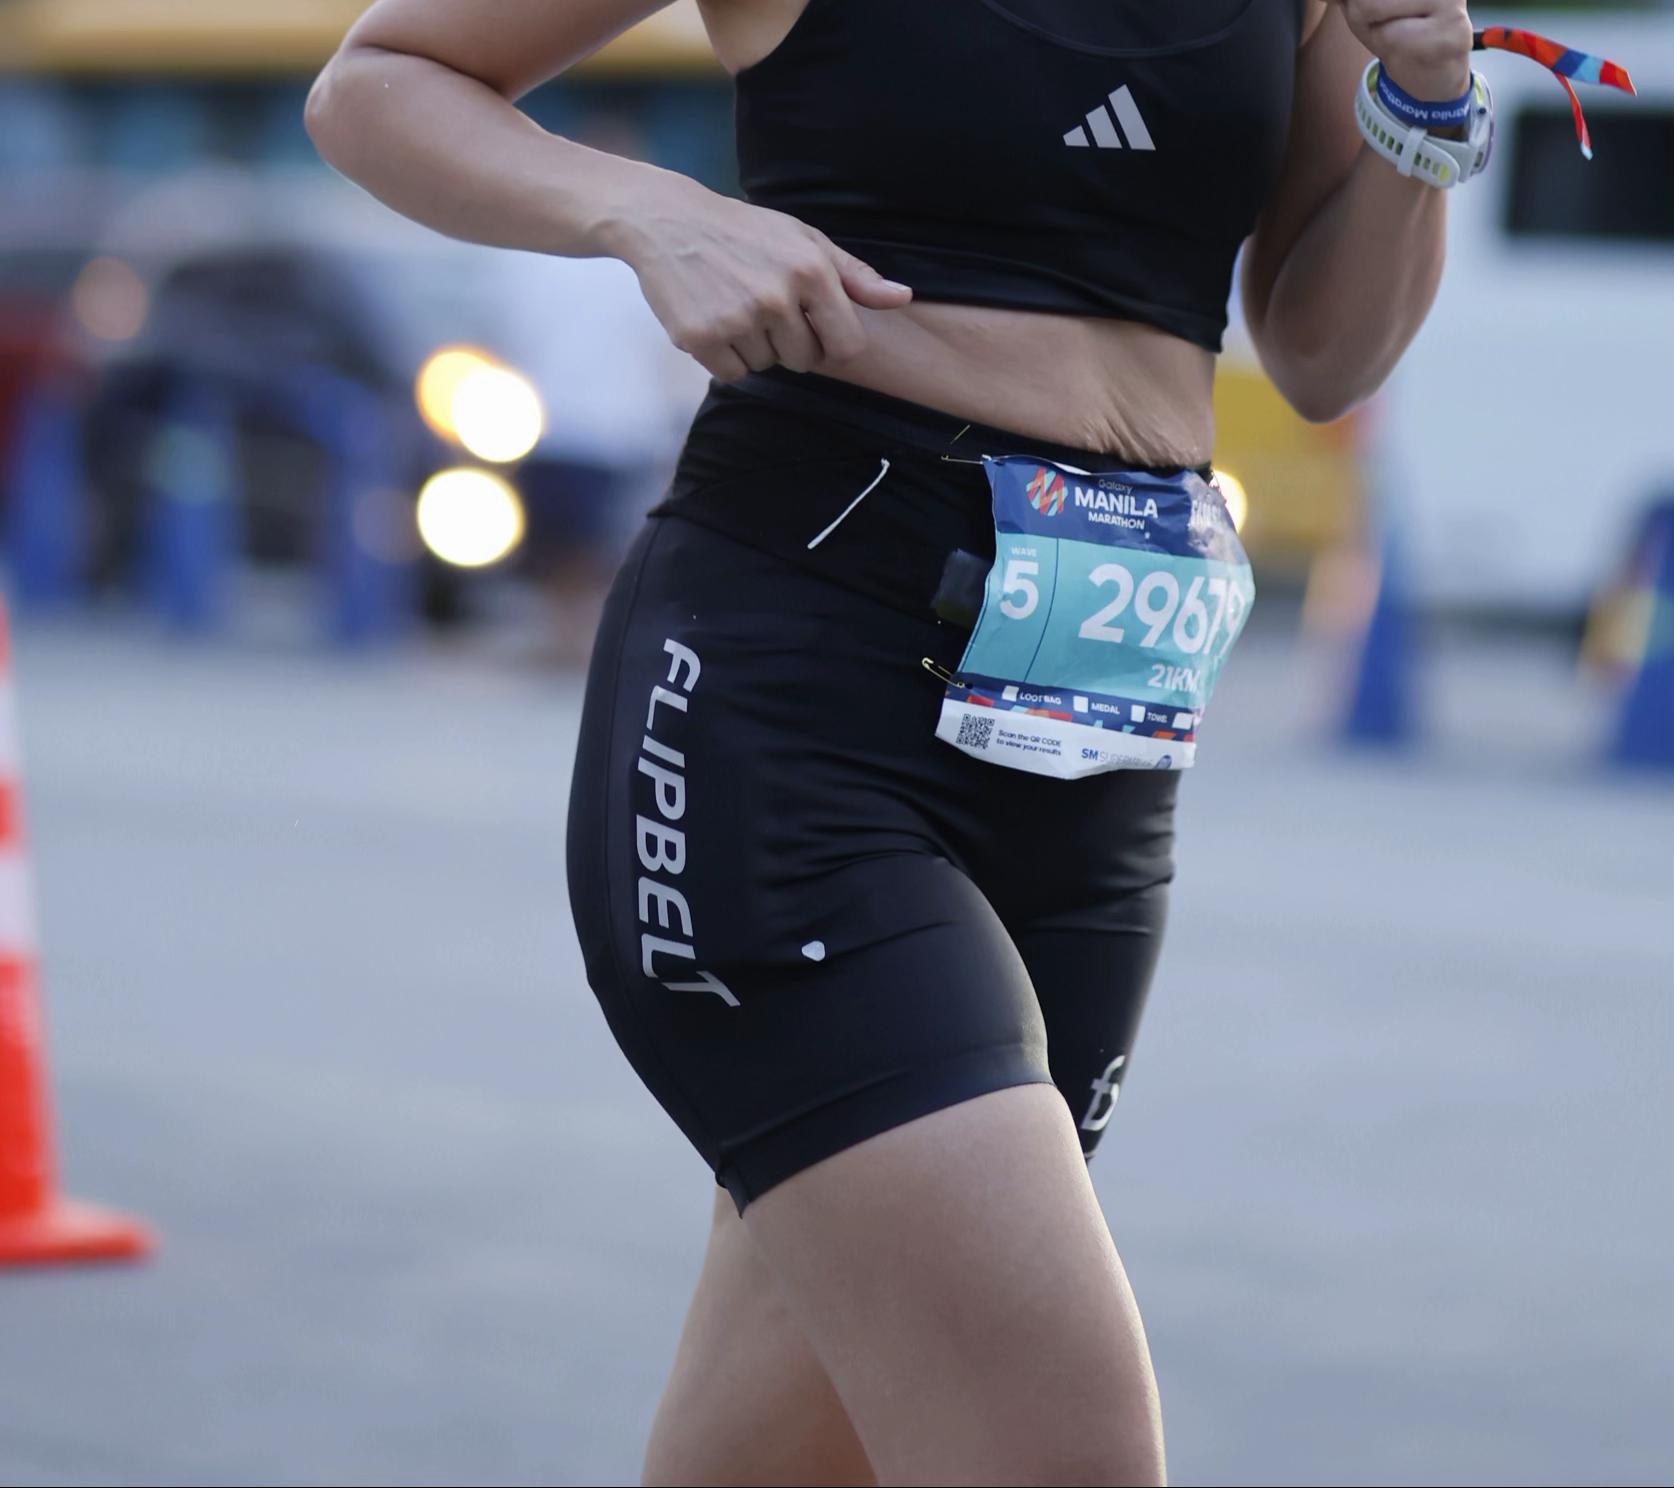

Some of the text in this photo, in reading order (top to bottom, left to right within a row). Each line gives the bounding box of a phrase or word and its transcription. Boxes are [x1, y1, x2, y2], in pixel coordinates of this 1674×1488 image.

[1099, 479, 1133, 494] Galaxy
[1074, 487, 1158, 518] MANILA
[1088, 512, 1145, 530] MARATHON
[1010, 546, 1037, 557] WAVE
[1000, 559, 1039, 620] 5
[1078, 563, 1246, 658] 29679
[1148, 664, 1200, 692] 21KM
[1020, 692, 1042, 703] LOOT
[1091, 702, 1120, 714] MEDAL
[1018, 734, 1028, 742] the
[1081, 748, 1098, 760] SM
[635, 638, 741, 1008] FLIPBELT
